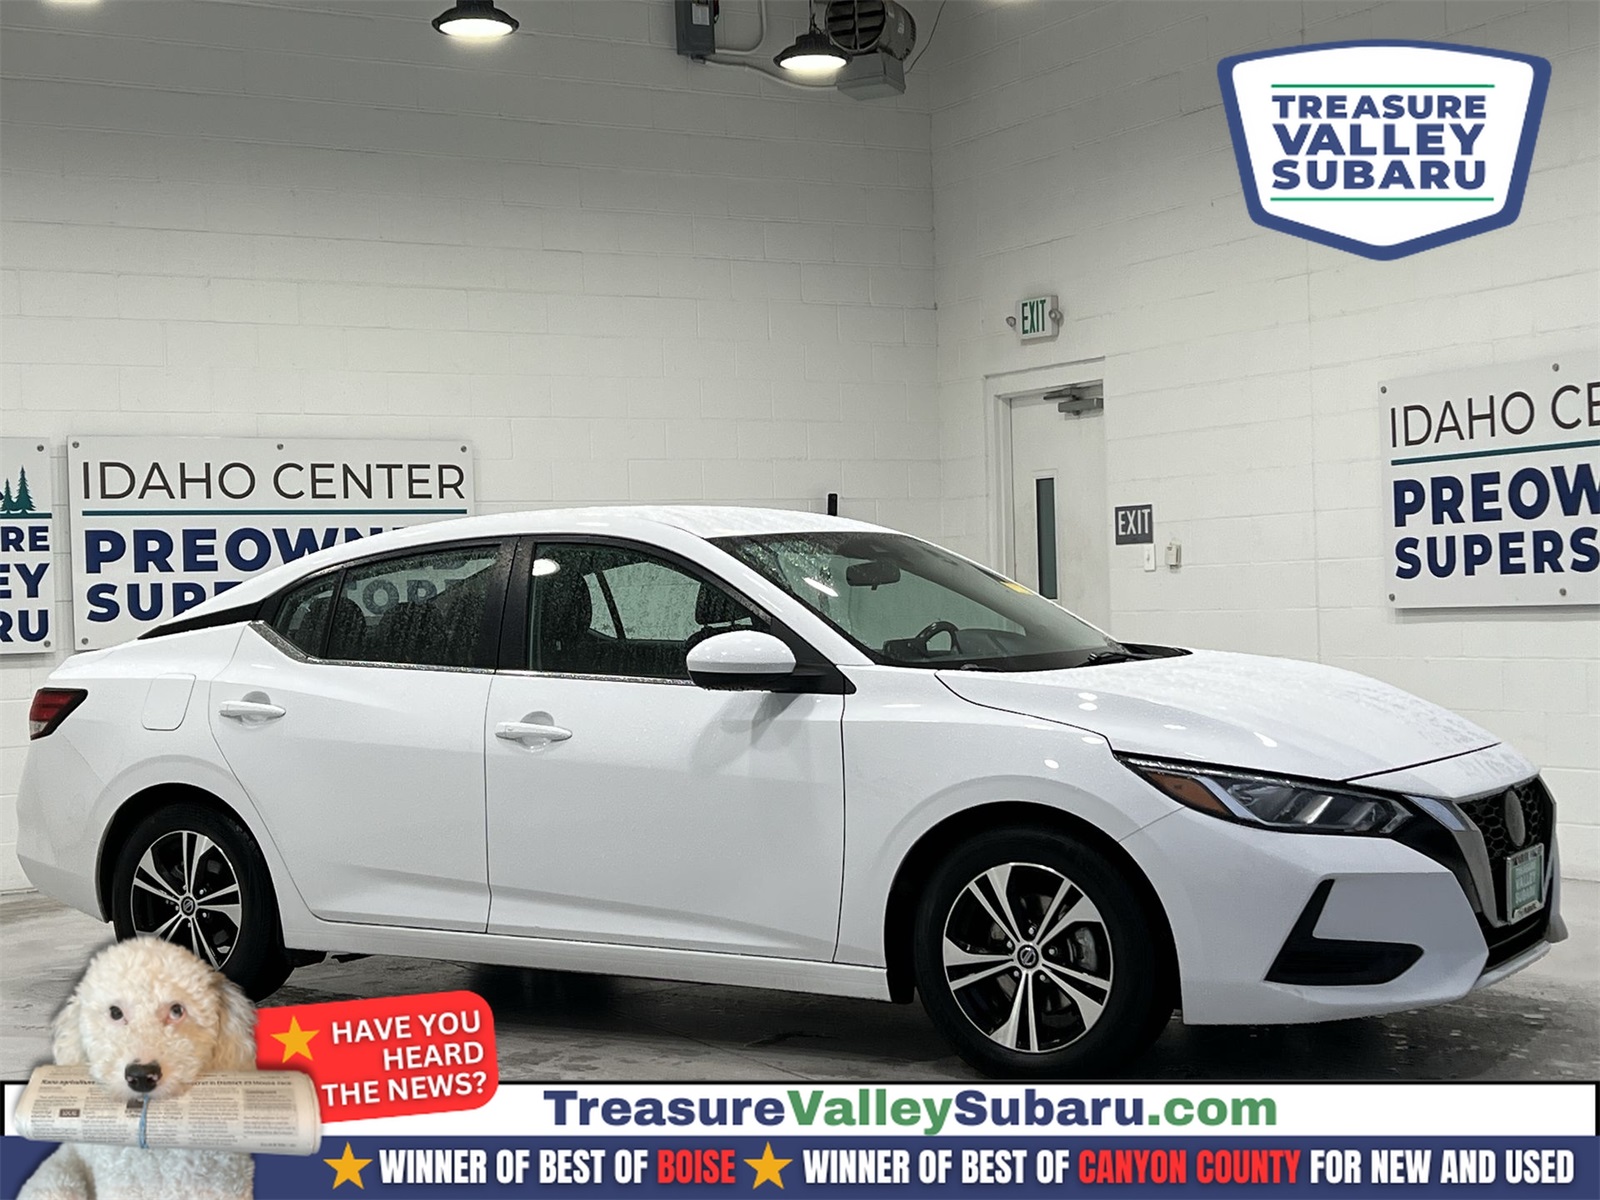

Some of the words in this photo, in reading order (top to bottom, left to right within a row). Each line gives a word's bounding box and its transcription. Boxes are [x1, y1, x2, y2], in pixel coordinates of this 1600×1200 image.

[1022, 300, 1046, 335] EXIT
[1390, 391, 1535, 448] IDAHO
[83, 462, 255, 499] IDAHO
[274, 463, 464, 499] CENTER
[1118, 508, 1150, 536] EXIT
[84, 527, 405, 574] PREOW
[1395, 527, 1600, 579] SUPERS
[87, 582, 242, 622] SUP
